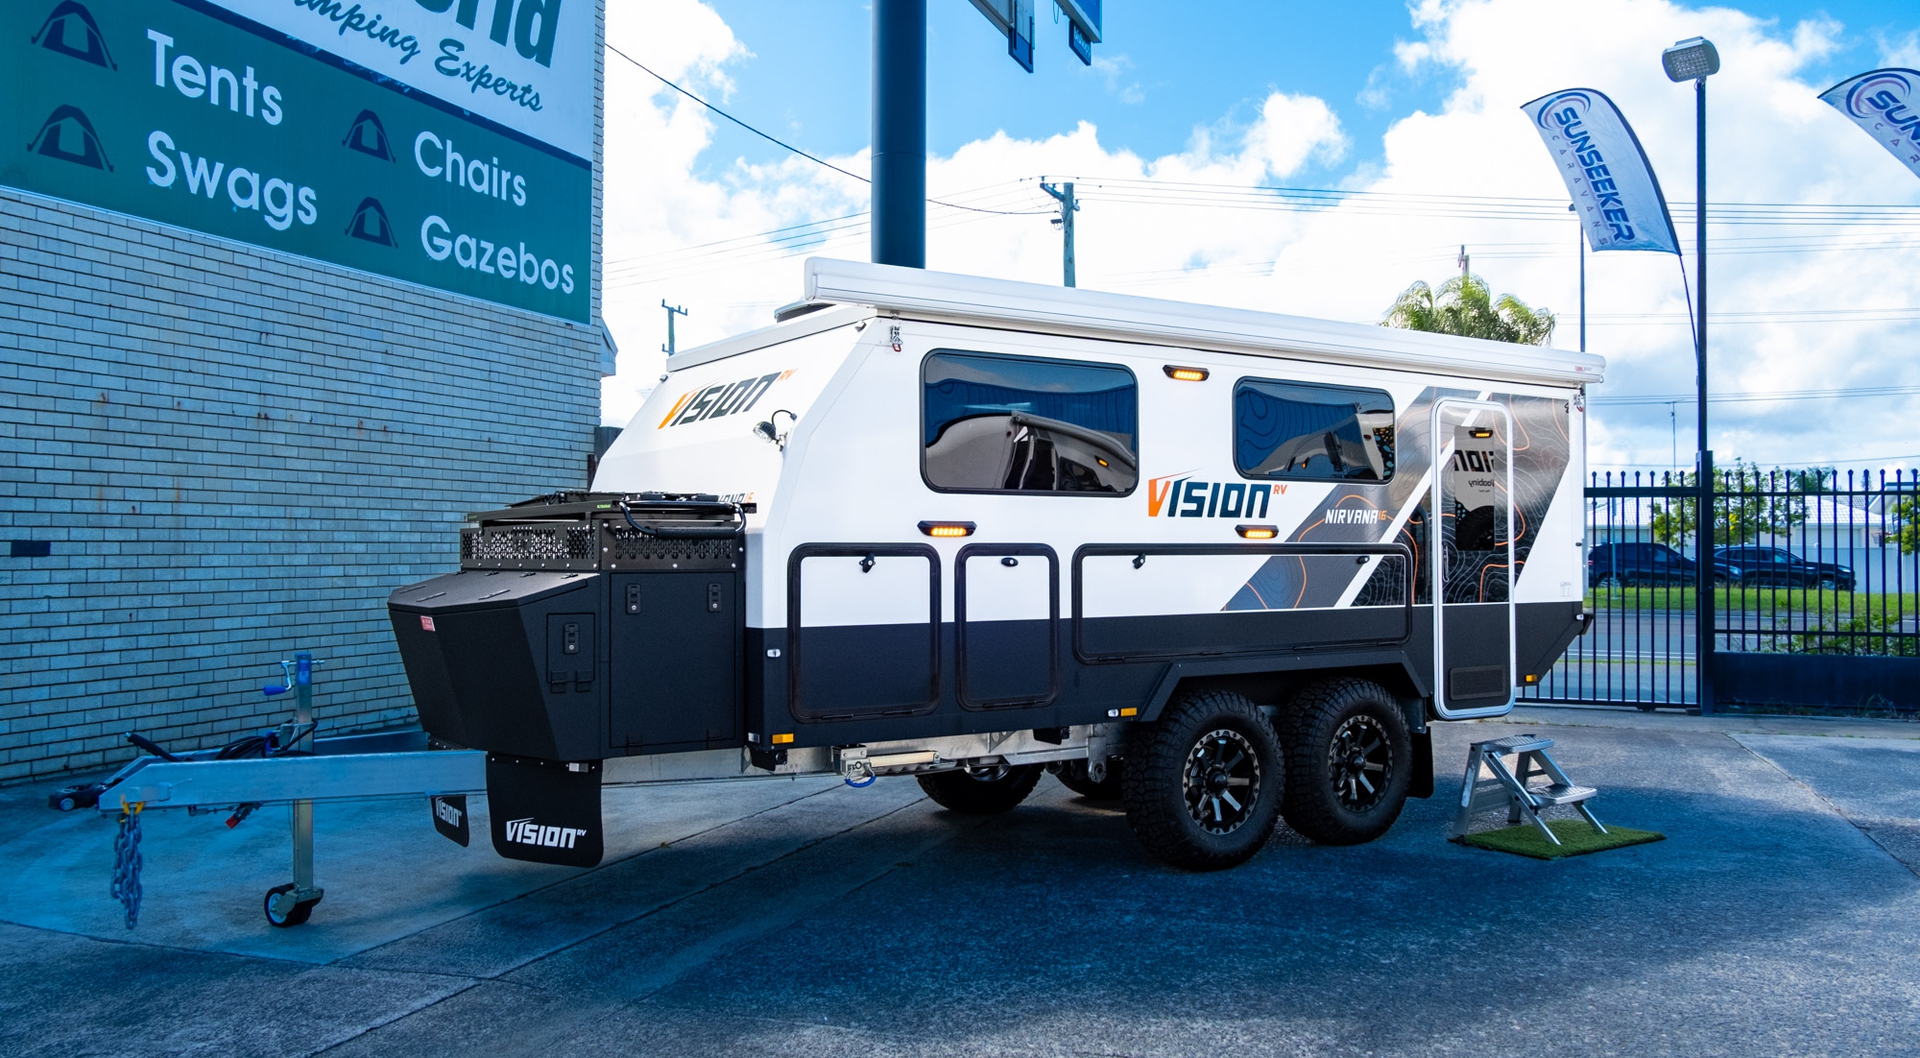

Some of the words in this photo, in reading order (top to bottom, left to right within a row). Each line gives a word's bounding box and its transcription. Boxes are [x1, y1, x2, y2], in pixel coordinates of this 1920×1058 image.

[146, 29, 283, 126] Tents
[434, 38, 543, 111] Experts
[146, 131, 318, 231] Swags
[414, 131, 527, 206] Chairs
[1552, 135, 1608, 246] CARAVANS
[1554, 106, 1636, 243] SUNSEEKER
[420, 215, 575, 294] Gazebos
[657, 371, 782, 430] VISION
[776, 367, 799, 382] RV
[1148, 468, 1271, 518] VISION
[1273, 484, 1288, 495] RV
[1325, 509, 1378, 524] NIRVANA
[435, 797, 460, 828] VISION
[506, 817, 577, 849] VISION
[577, 828, 587, 837] RV
